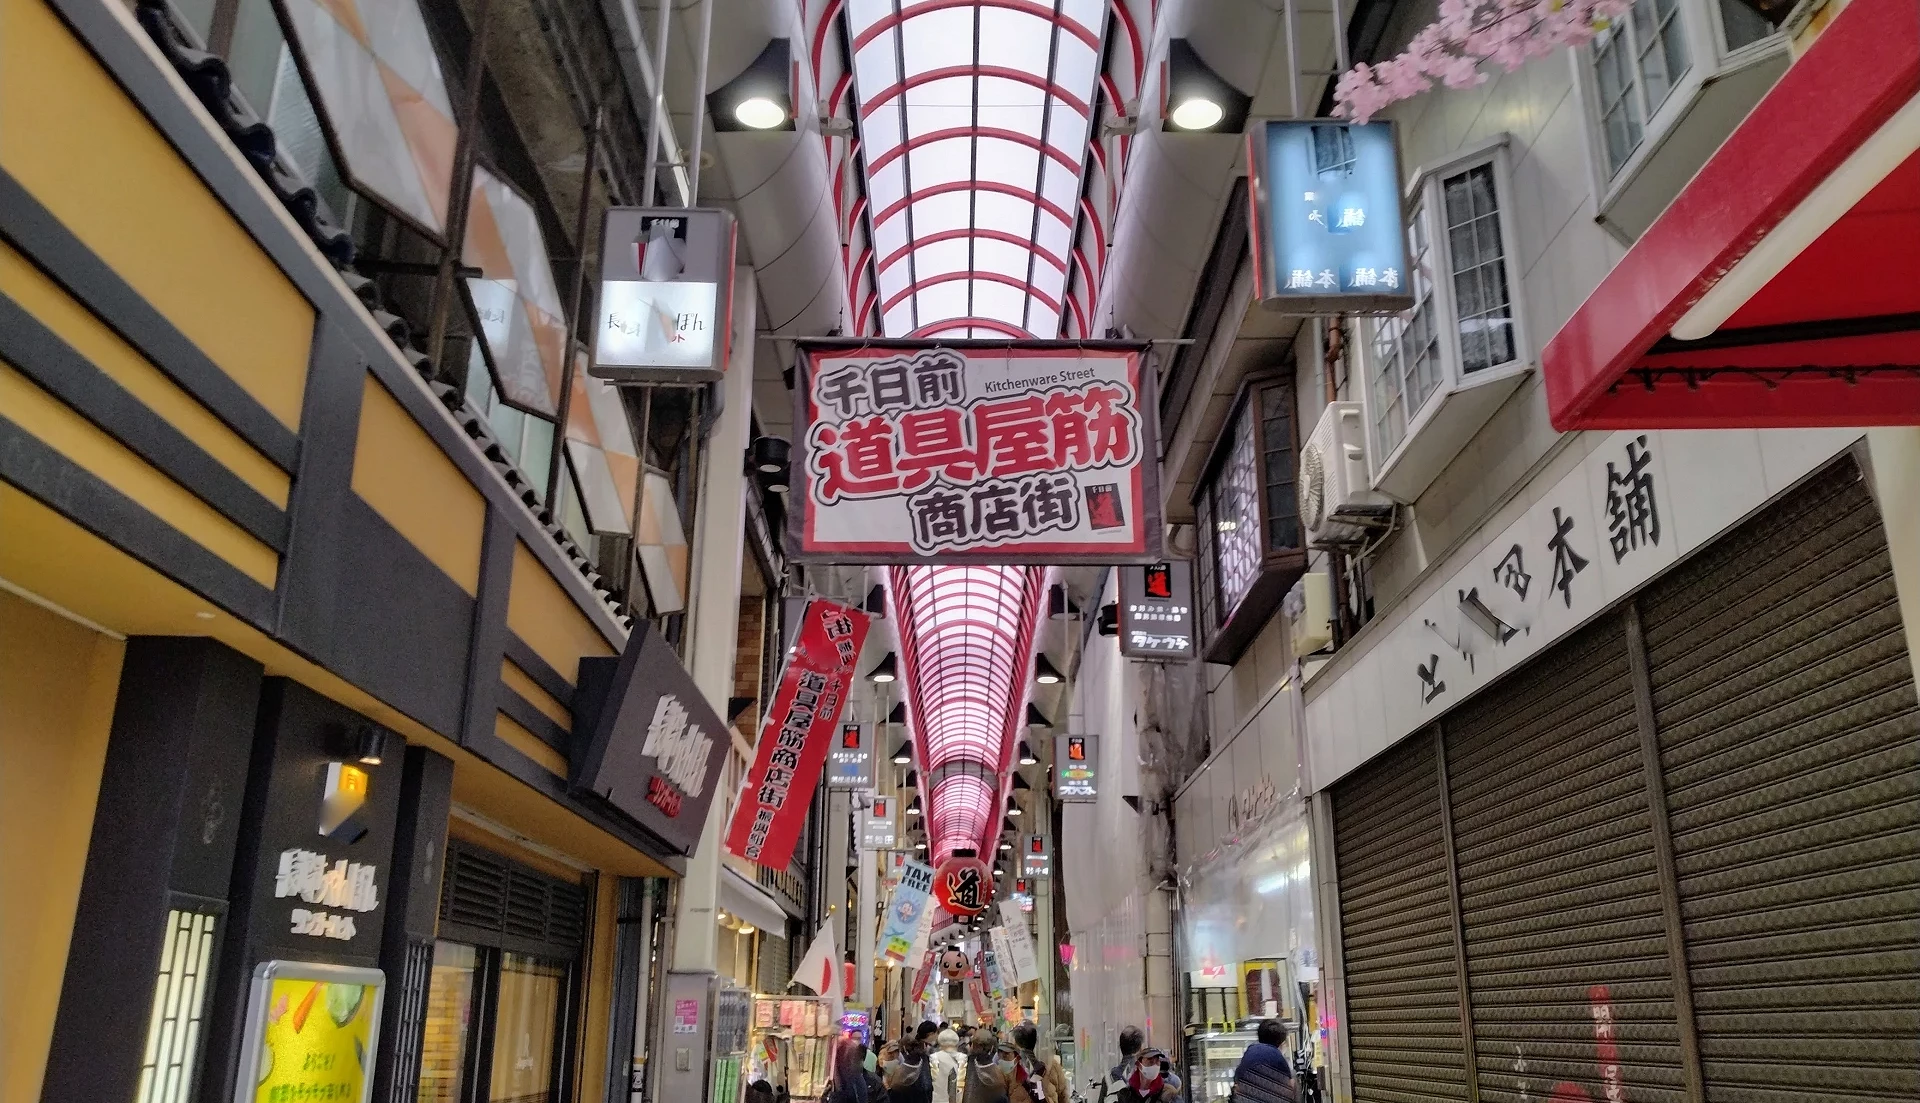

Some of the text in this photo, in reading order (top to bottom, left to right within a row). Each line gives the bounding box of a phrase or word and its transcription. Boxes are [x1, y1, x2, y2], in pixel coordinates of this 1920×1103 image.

[824, 358, 960, 417] 千日前
[984, 367, 1096, 394] Kitchenware Street
[818, 386, 1131, 500] 道具屋筋
[914, 477, 1076, 543] 商店街
[901, 875, 930, 893] FREE
[905, 863, 932, 884] TAX
[947, 867, 985, 911] 道
